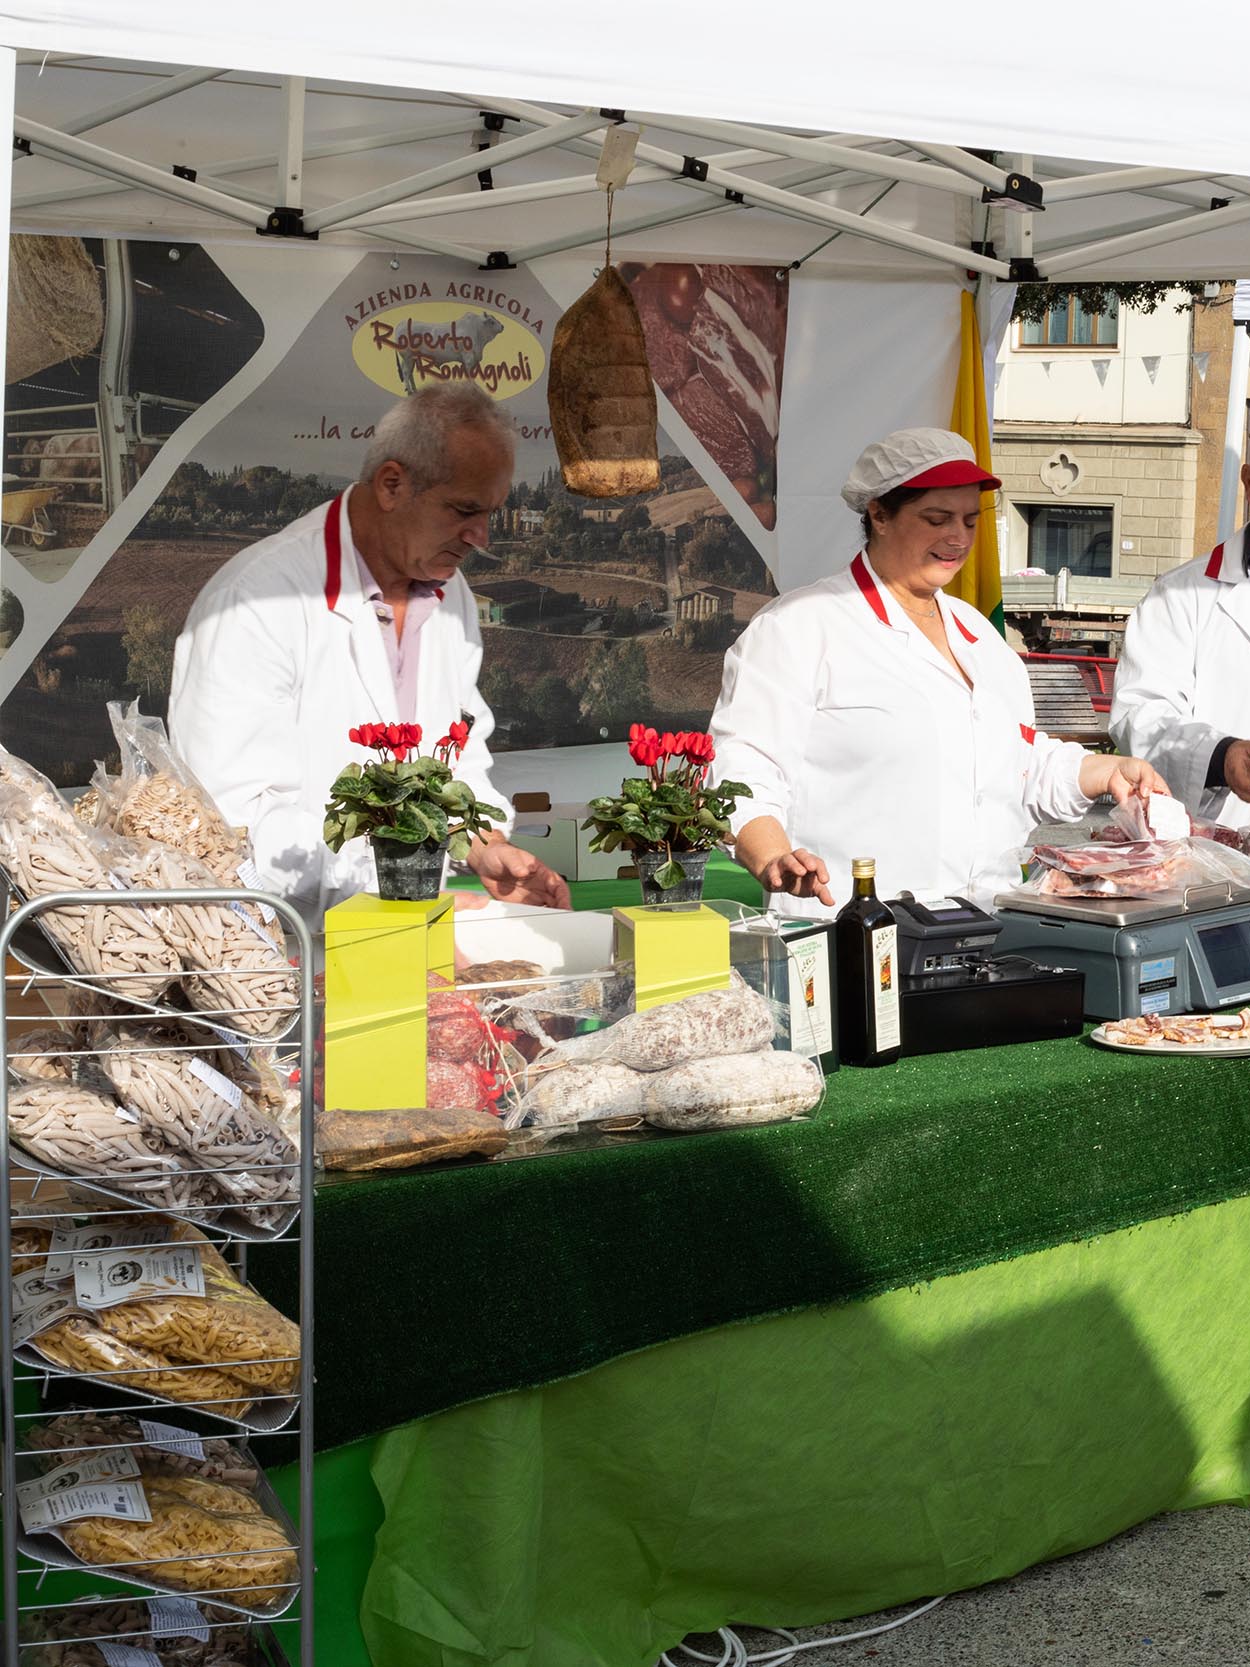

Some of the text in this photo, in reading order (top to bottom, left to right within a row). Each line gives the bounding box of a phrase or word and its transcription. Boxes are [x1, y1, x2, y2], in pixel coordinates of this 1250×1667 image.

[344, 281, 544, 334] AZIENDA AGRICOLA
[370, 318, 473, 350] Roberto
[413, 351, 532, 393] Romagnoli
[350, 424, 376, 440] ca
